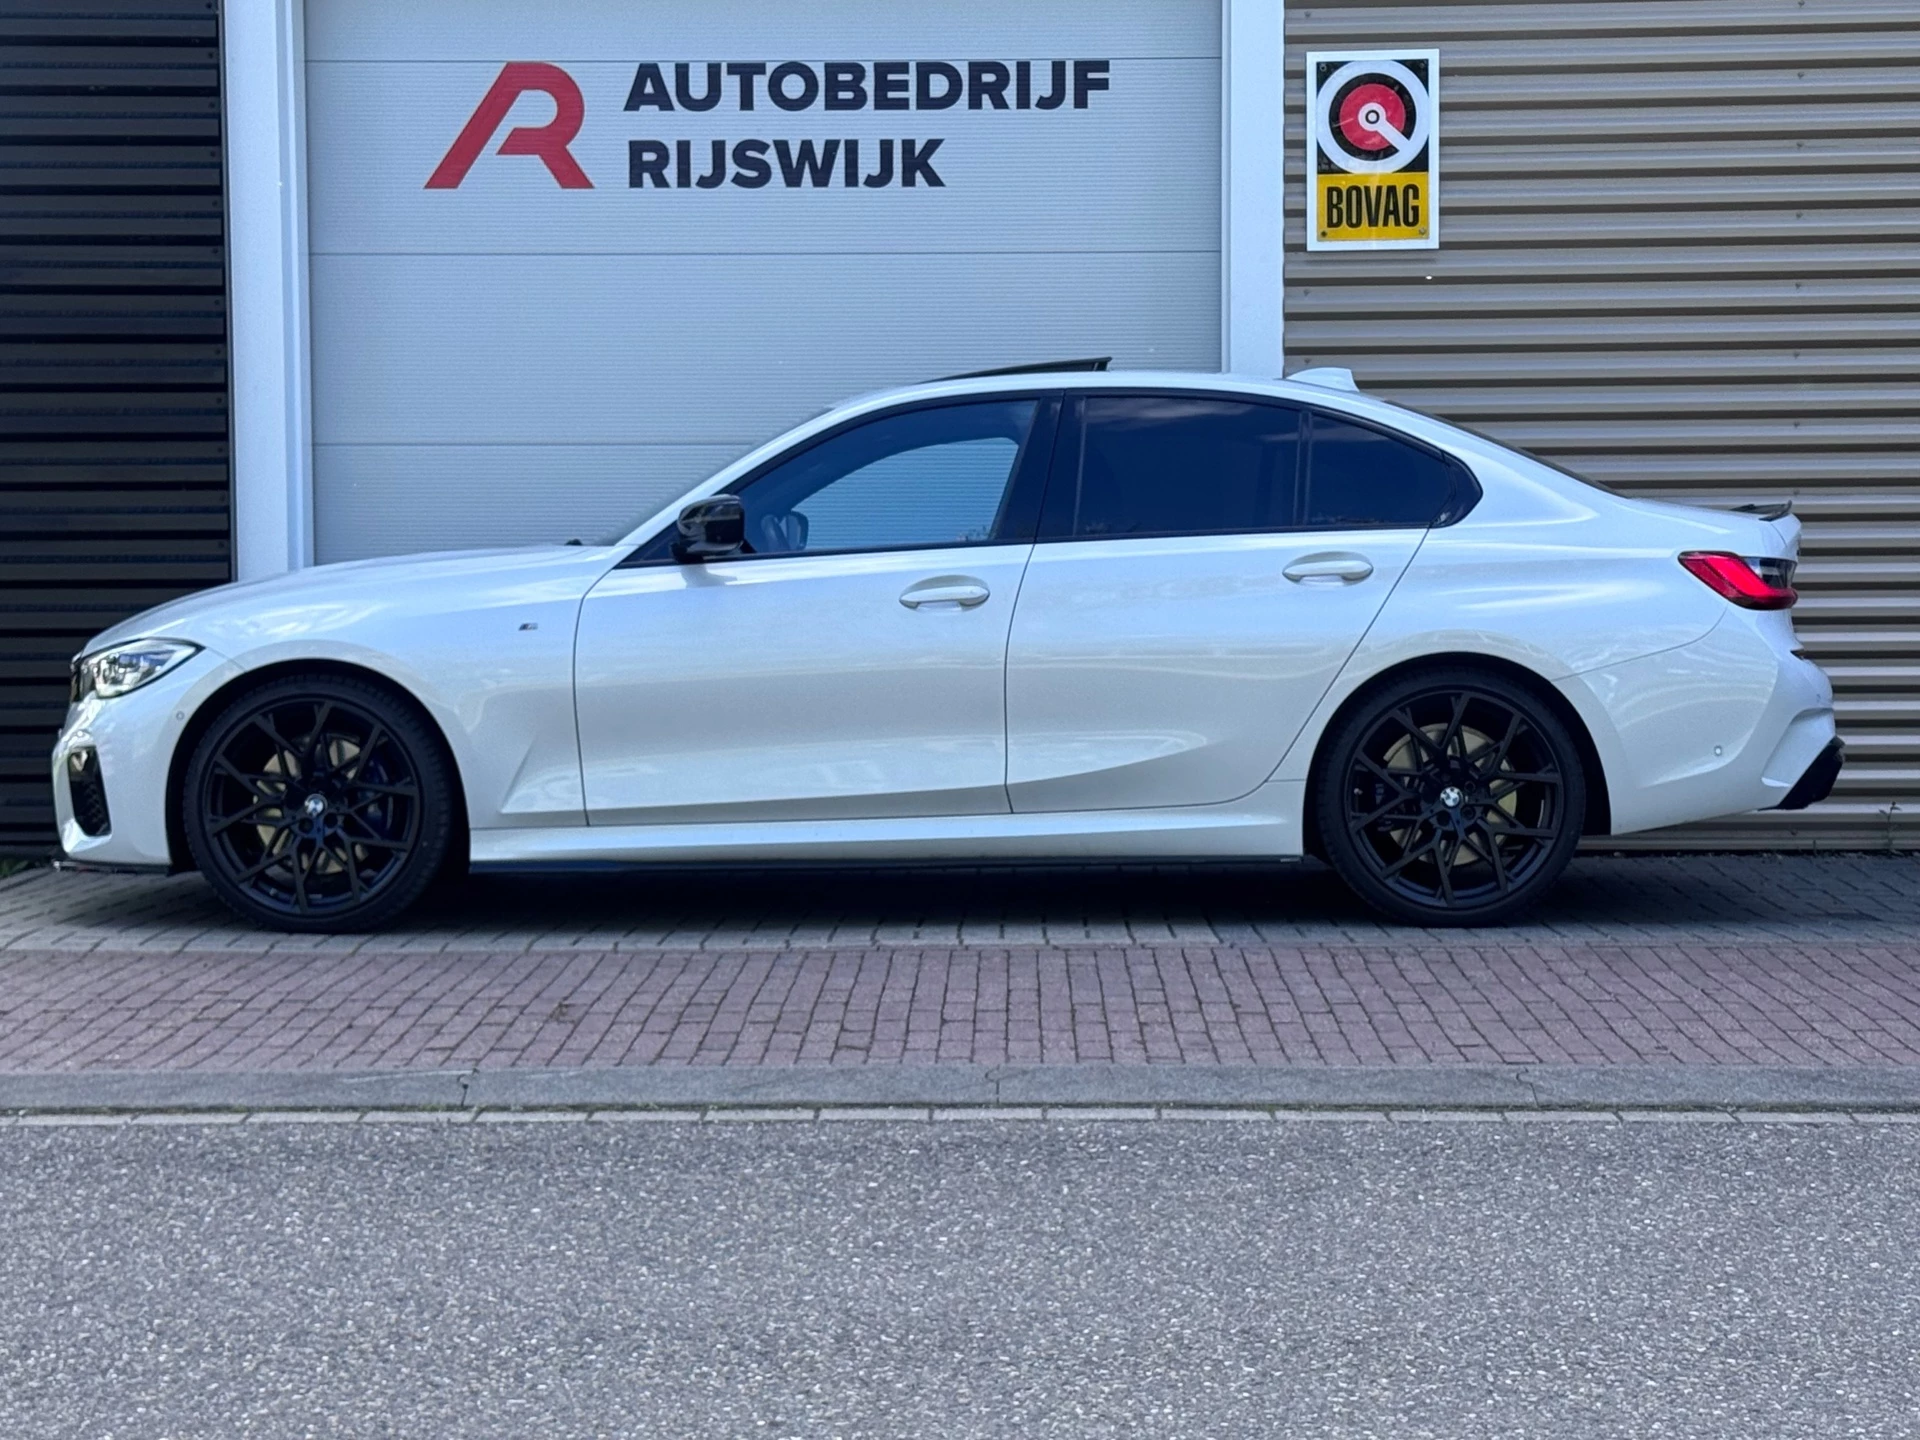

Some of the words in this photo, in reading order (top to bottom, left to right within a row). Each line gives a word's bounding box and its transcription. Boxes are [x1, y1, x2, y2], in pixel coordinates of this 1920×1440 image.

[623, 60, 1110, 112] AUTOBEDRIJF
[628, 139, 946, 189] RIJSWIJK
[1326, 184, 1420, 229] BOVAG
